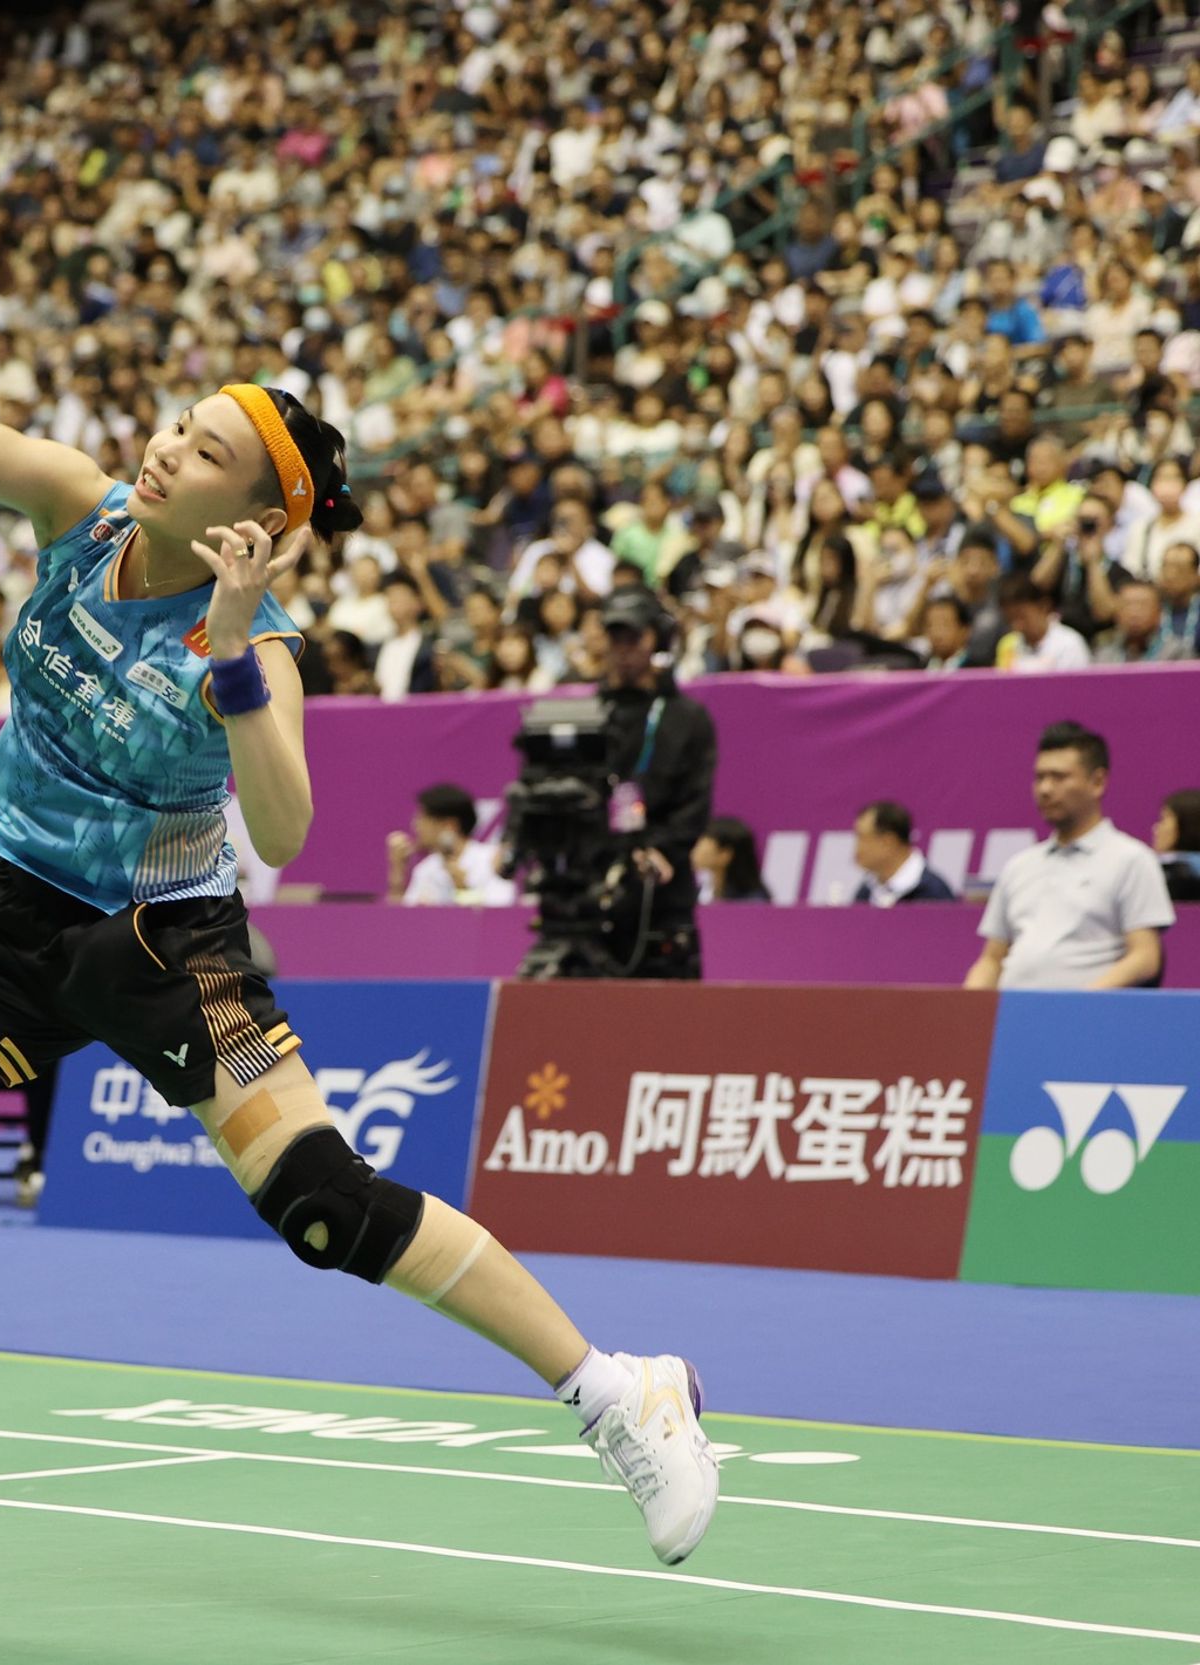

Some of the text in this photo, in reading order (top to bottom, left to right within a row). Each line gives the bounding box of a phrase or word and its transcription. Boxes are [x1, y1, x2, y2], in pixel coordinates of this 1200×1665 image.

[83, 1131, 193, 1173] Chunghwa
[485, 1106, 609, 1175] Amo
[618, 1072, 972, 1188] 阿默蛋糕
[50, 1398, 549, 1448] YONEX
